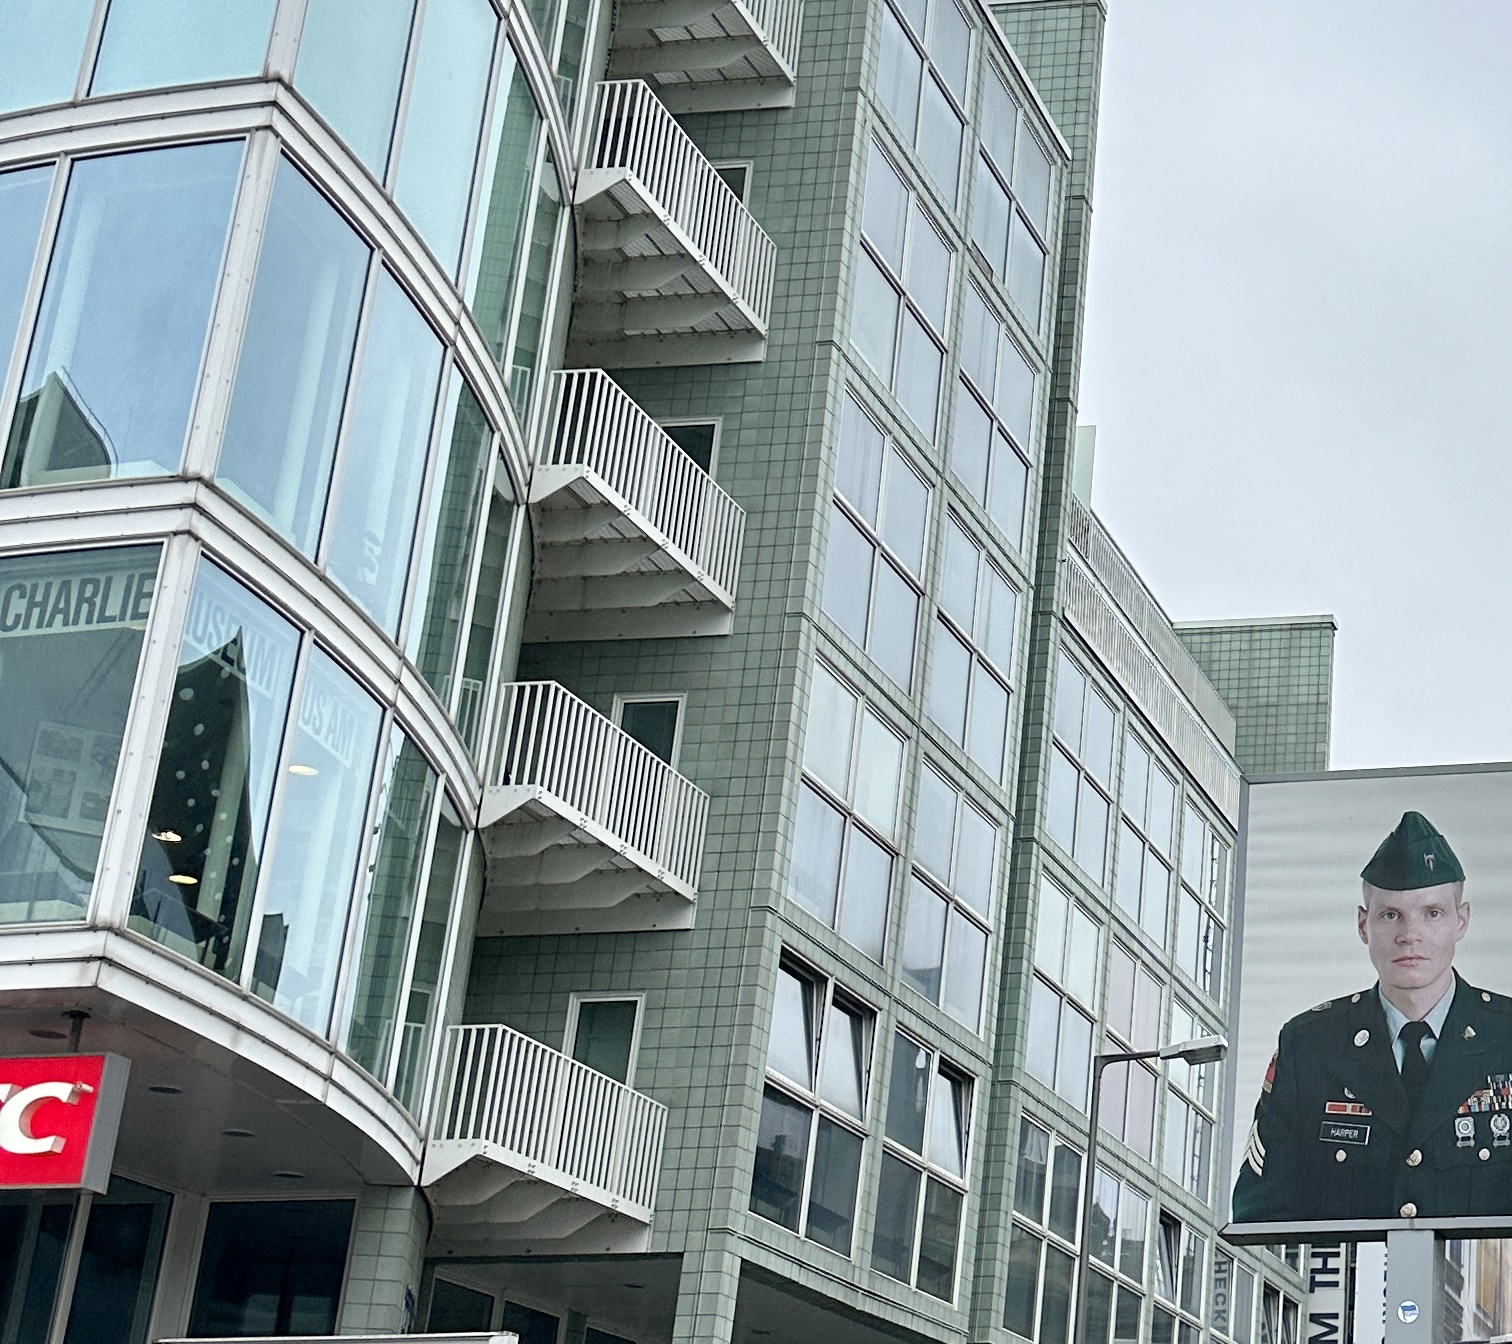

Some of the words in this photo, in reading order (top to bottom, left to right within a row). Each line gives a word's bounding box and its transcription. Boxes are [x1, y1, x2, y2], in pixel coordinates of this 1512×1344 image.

[0, 572, 156, 632] CHARLIE
[1330, 1128, 1359, 1138] HARPER
[1309, 1244, 1342, 1293] TH
